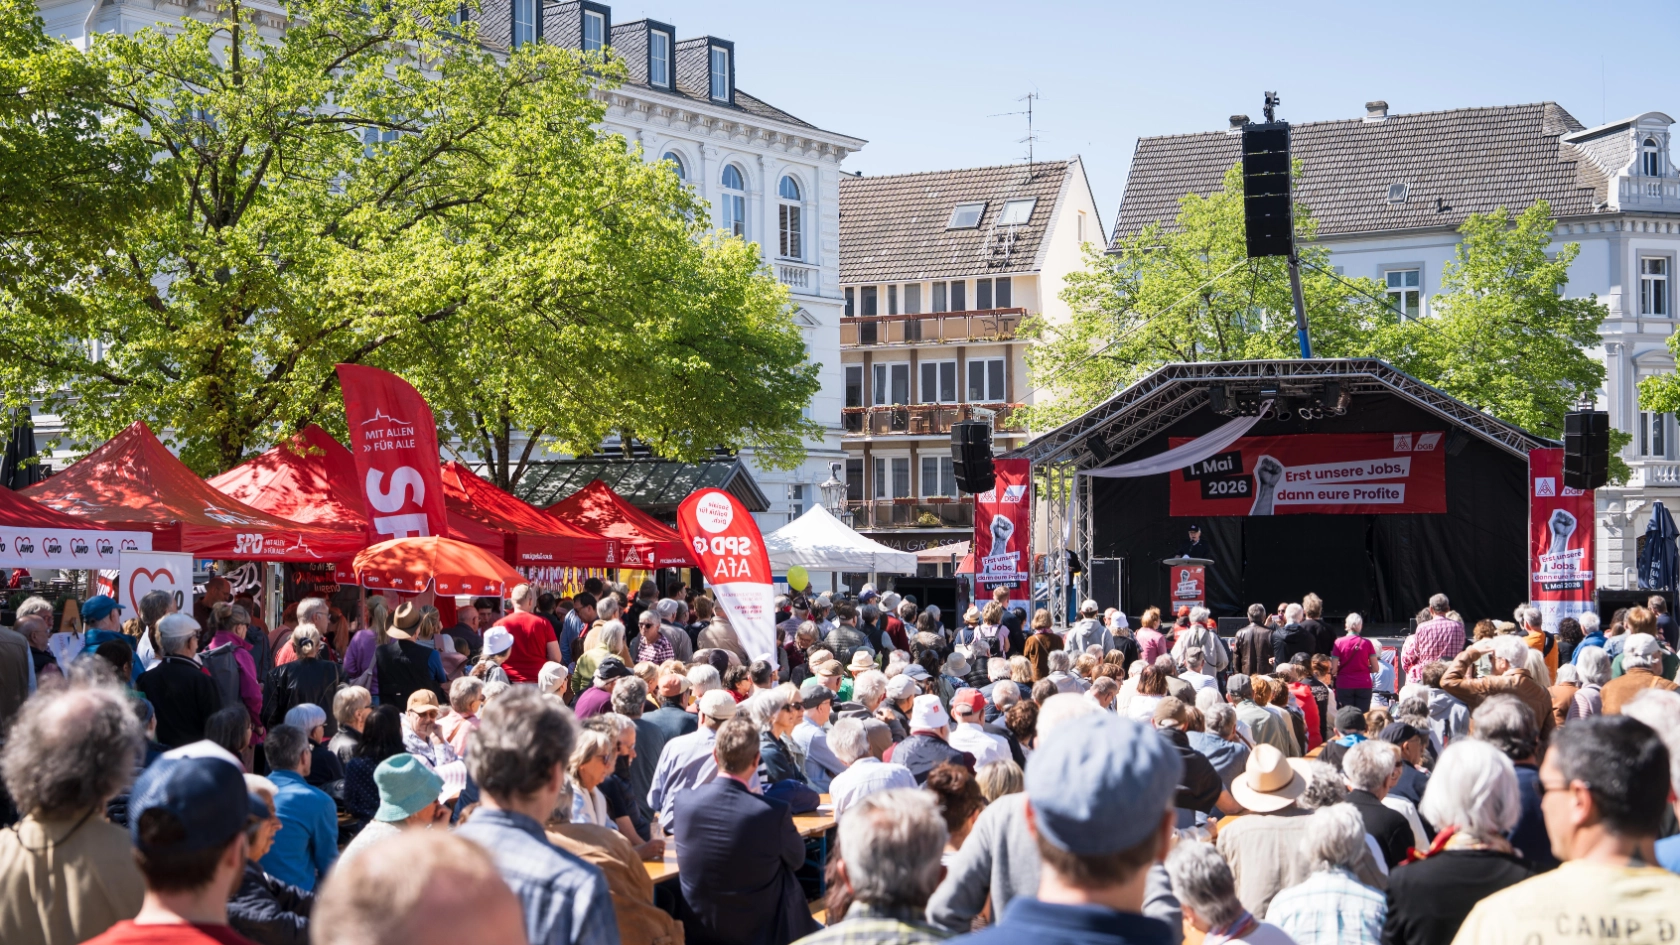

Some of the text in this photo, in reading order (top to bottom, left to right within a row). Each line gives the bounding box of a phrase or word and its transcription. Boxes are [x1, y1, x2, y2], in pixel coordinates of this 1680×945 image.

[365, 427, 414, 439] MIT ALLEN
[374, 440, 393, 451] FÜR
[395, 439, 416, 449] ALLE
[1203, 456, 1233, 474] Mai
[1285, 461, 1406, 483] Erst unsere Jobs,
[1208, 480, 1248, 496] 2026
[1277, 487, 1400, 501] dann eure Profite
[20, 544, 34, 553] AWO
[48, 545, 62, 554] AWO
[75, 545, 89, 554] AWO
[233, 533, 264, 554] SPD
[100, 546, 114, 555] AWO
[1557, 551, 1582, 560] unsere
[992, 563, 1015, 572] Jobs,
[1551, 562, 1577, 571] Jobs,
[1556, 912, 1641, 938] CAMP
